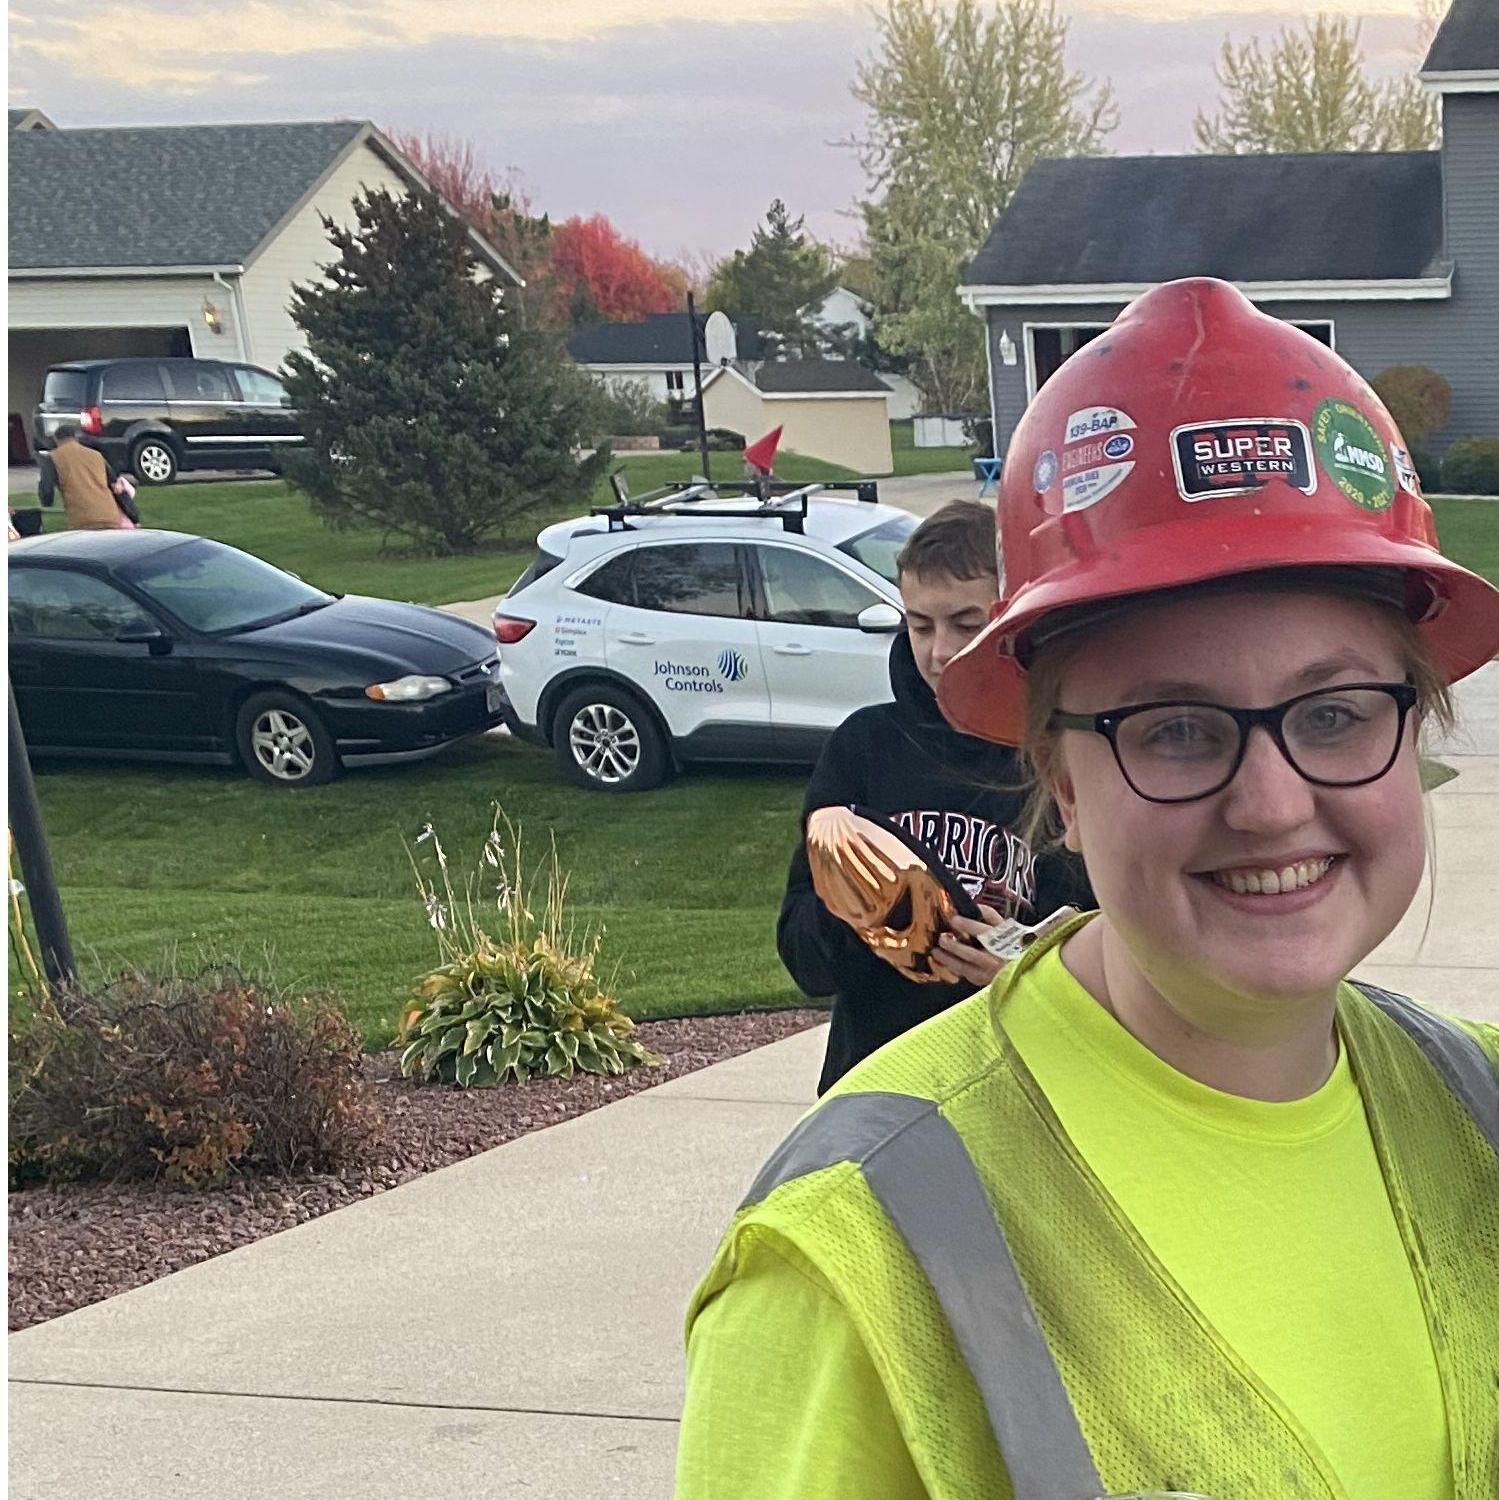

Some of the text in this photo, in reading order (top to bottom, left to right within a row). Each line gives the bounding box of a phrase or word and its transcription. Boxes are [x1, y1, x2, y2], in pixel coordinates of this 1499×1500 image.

[1193, 436, 1294, 461] SUPER
[1200, 460, 1294, 475] WESTERN
[654, 660, 710, 677] Johnson
[665, 677, 724, 693] Controls
[889, 811, 1038, 902] RRIOR
